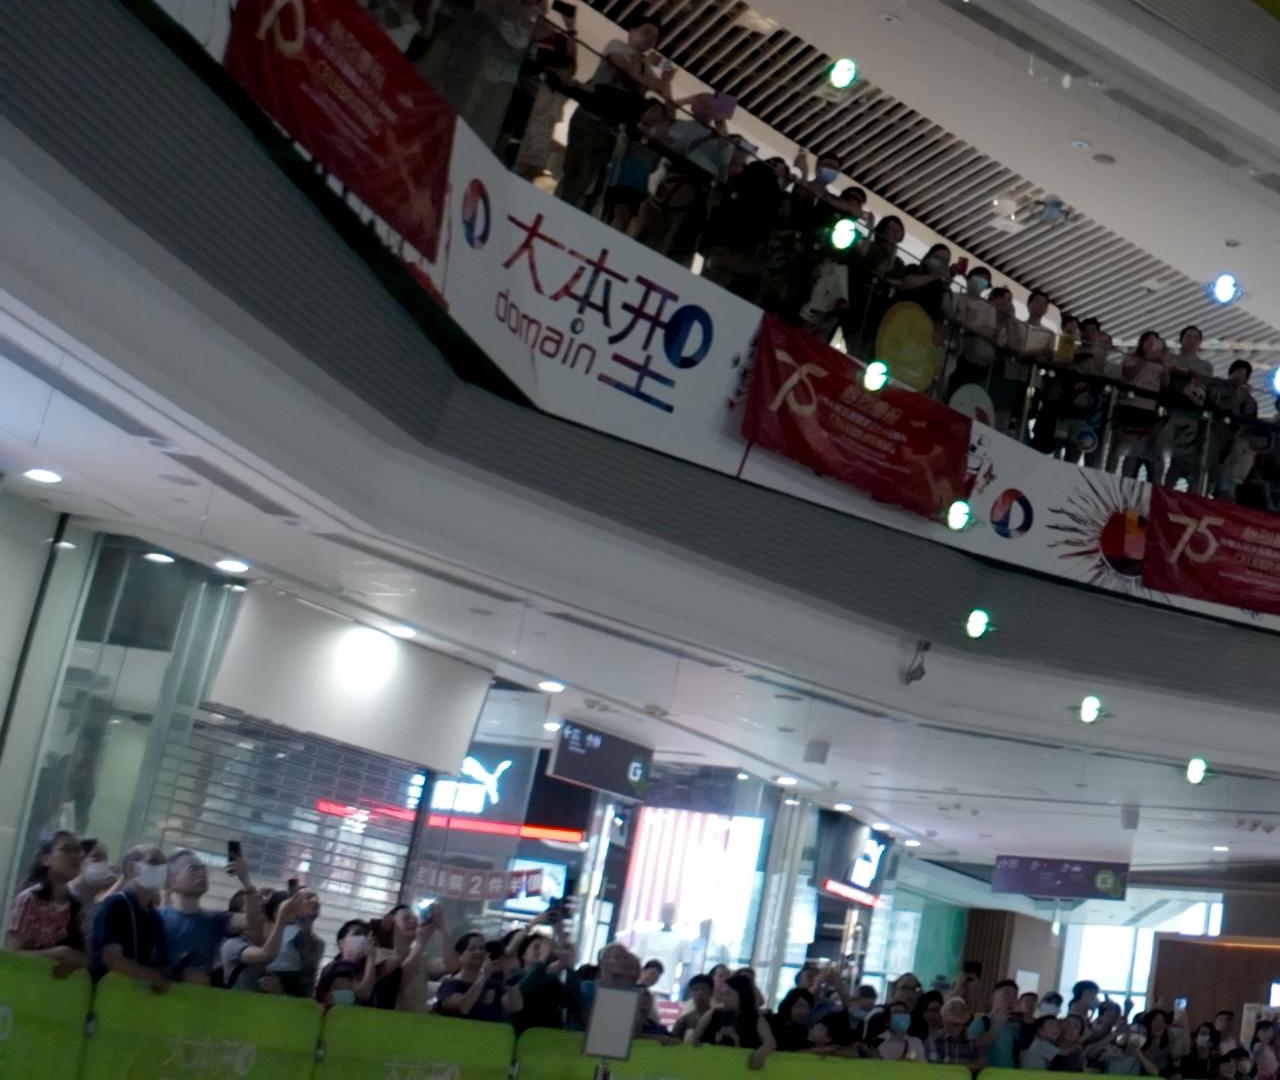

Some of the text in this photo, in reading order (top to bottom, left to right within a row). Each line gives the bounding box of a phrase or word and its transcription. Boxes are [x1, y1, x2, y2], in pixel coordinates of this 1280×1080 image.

[494, 289, 599, 377] domain
[769, 348, 831, 416] 75
[1166, 512, 1226, 565] 75
[627, 761, 643, 782] G
